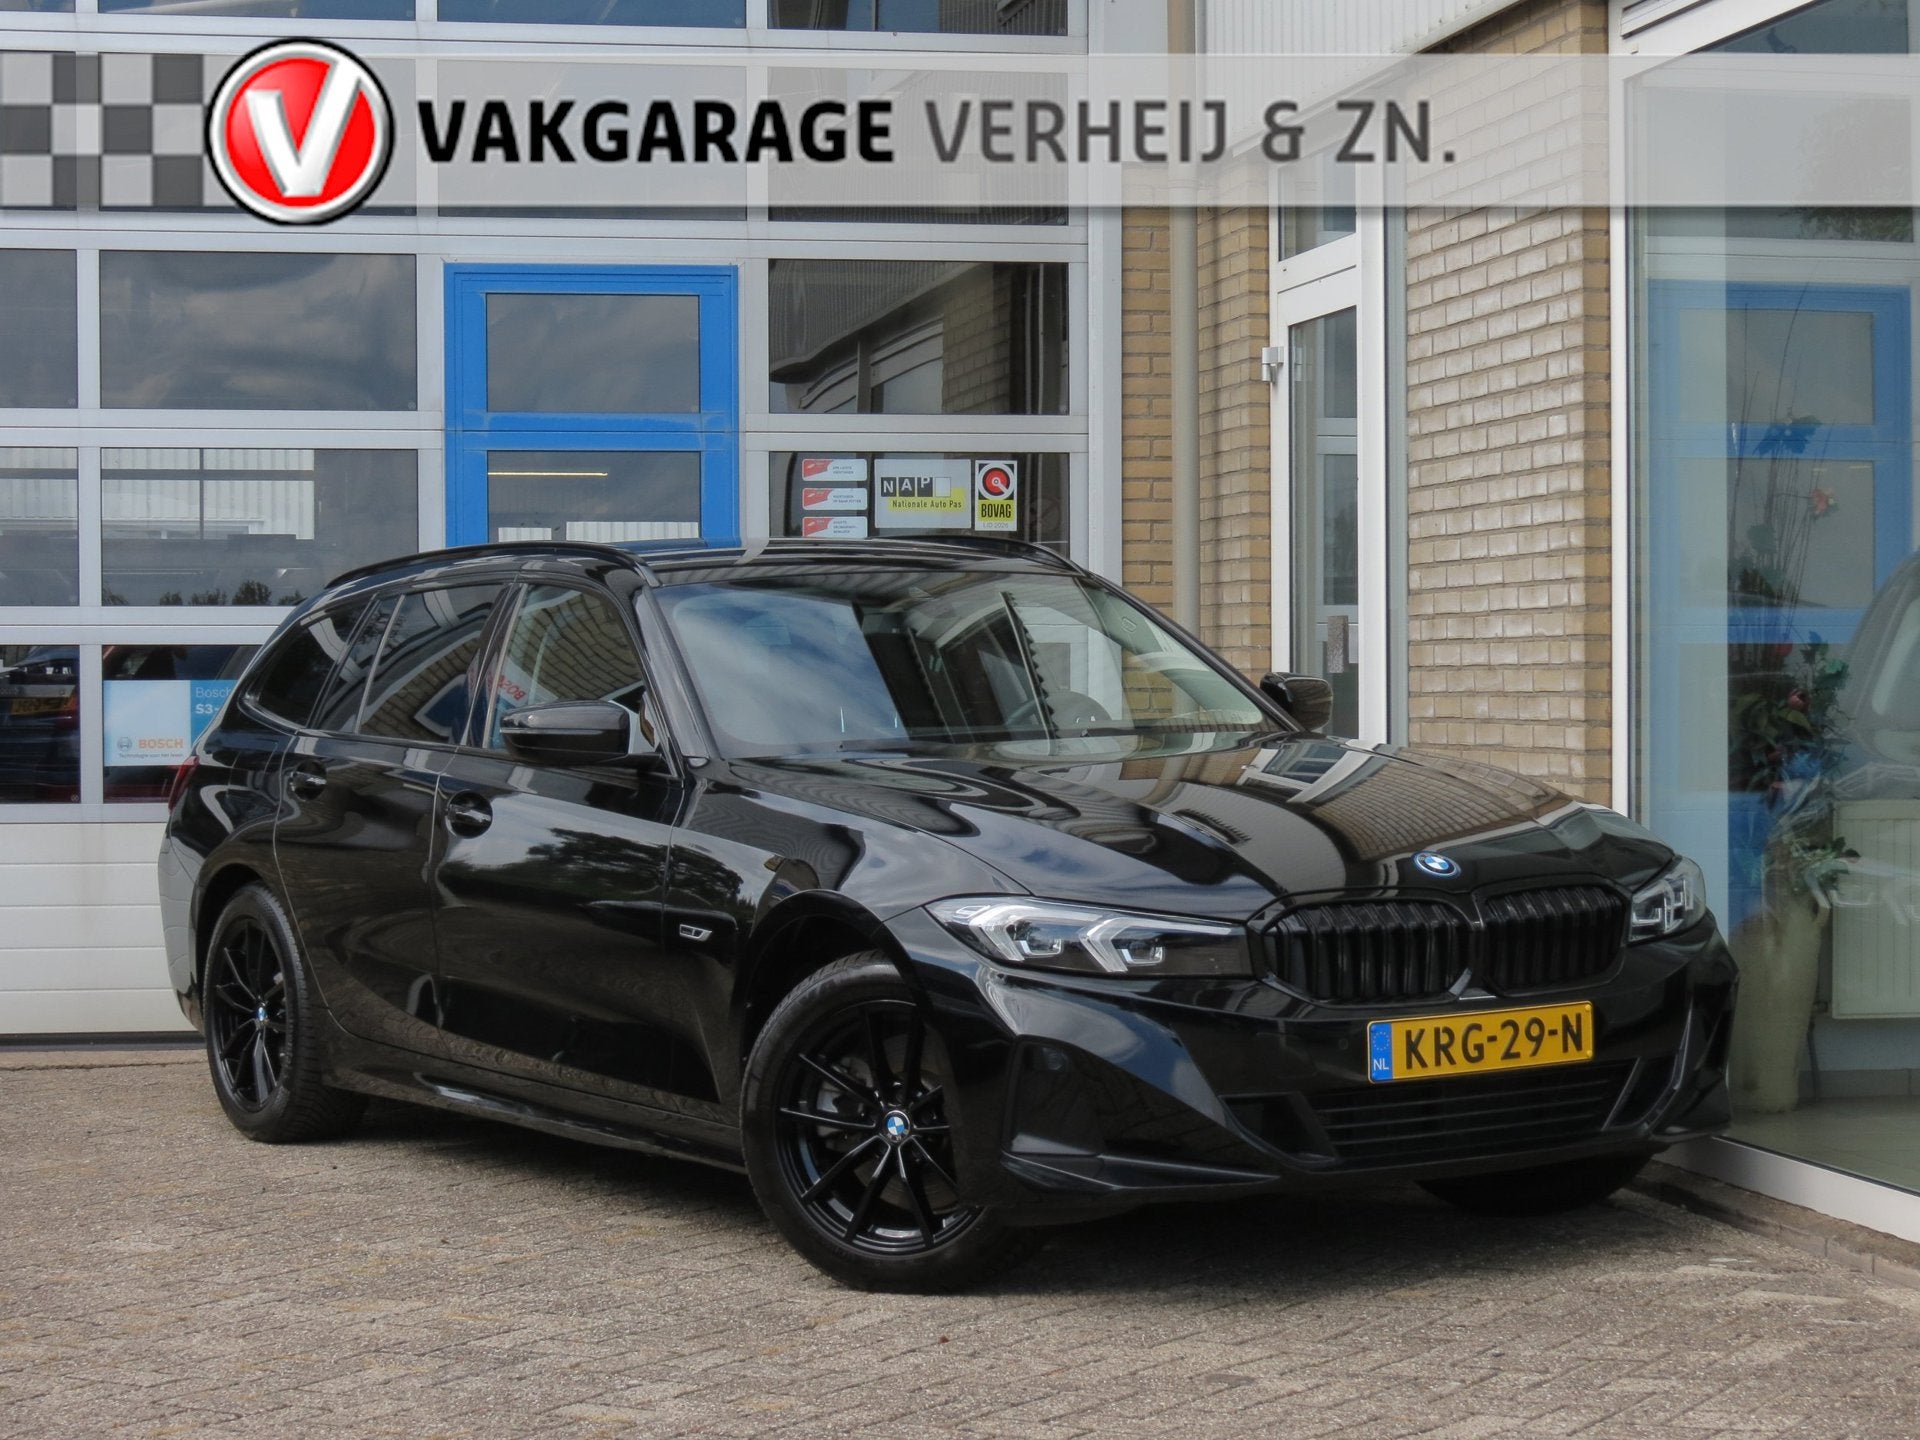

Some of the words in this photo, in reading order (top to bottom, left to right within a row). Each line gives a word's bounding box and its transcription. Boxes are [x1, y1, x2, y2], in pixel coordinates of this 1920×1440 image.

[882, 476, 932, 494] NAP
[892, 500, 928, 508] Nationale
[930, 500, 947, 508] Auto
[949, 500, 962, 508] Pas
[981, 503, 1012, 518] BOVAG
[138, 738, 184, 749] BOSCH
[1405, 1012, 1583, 1070] KRG-29-N
[1373, 1058, 1389, 1071] NL
